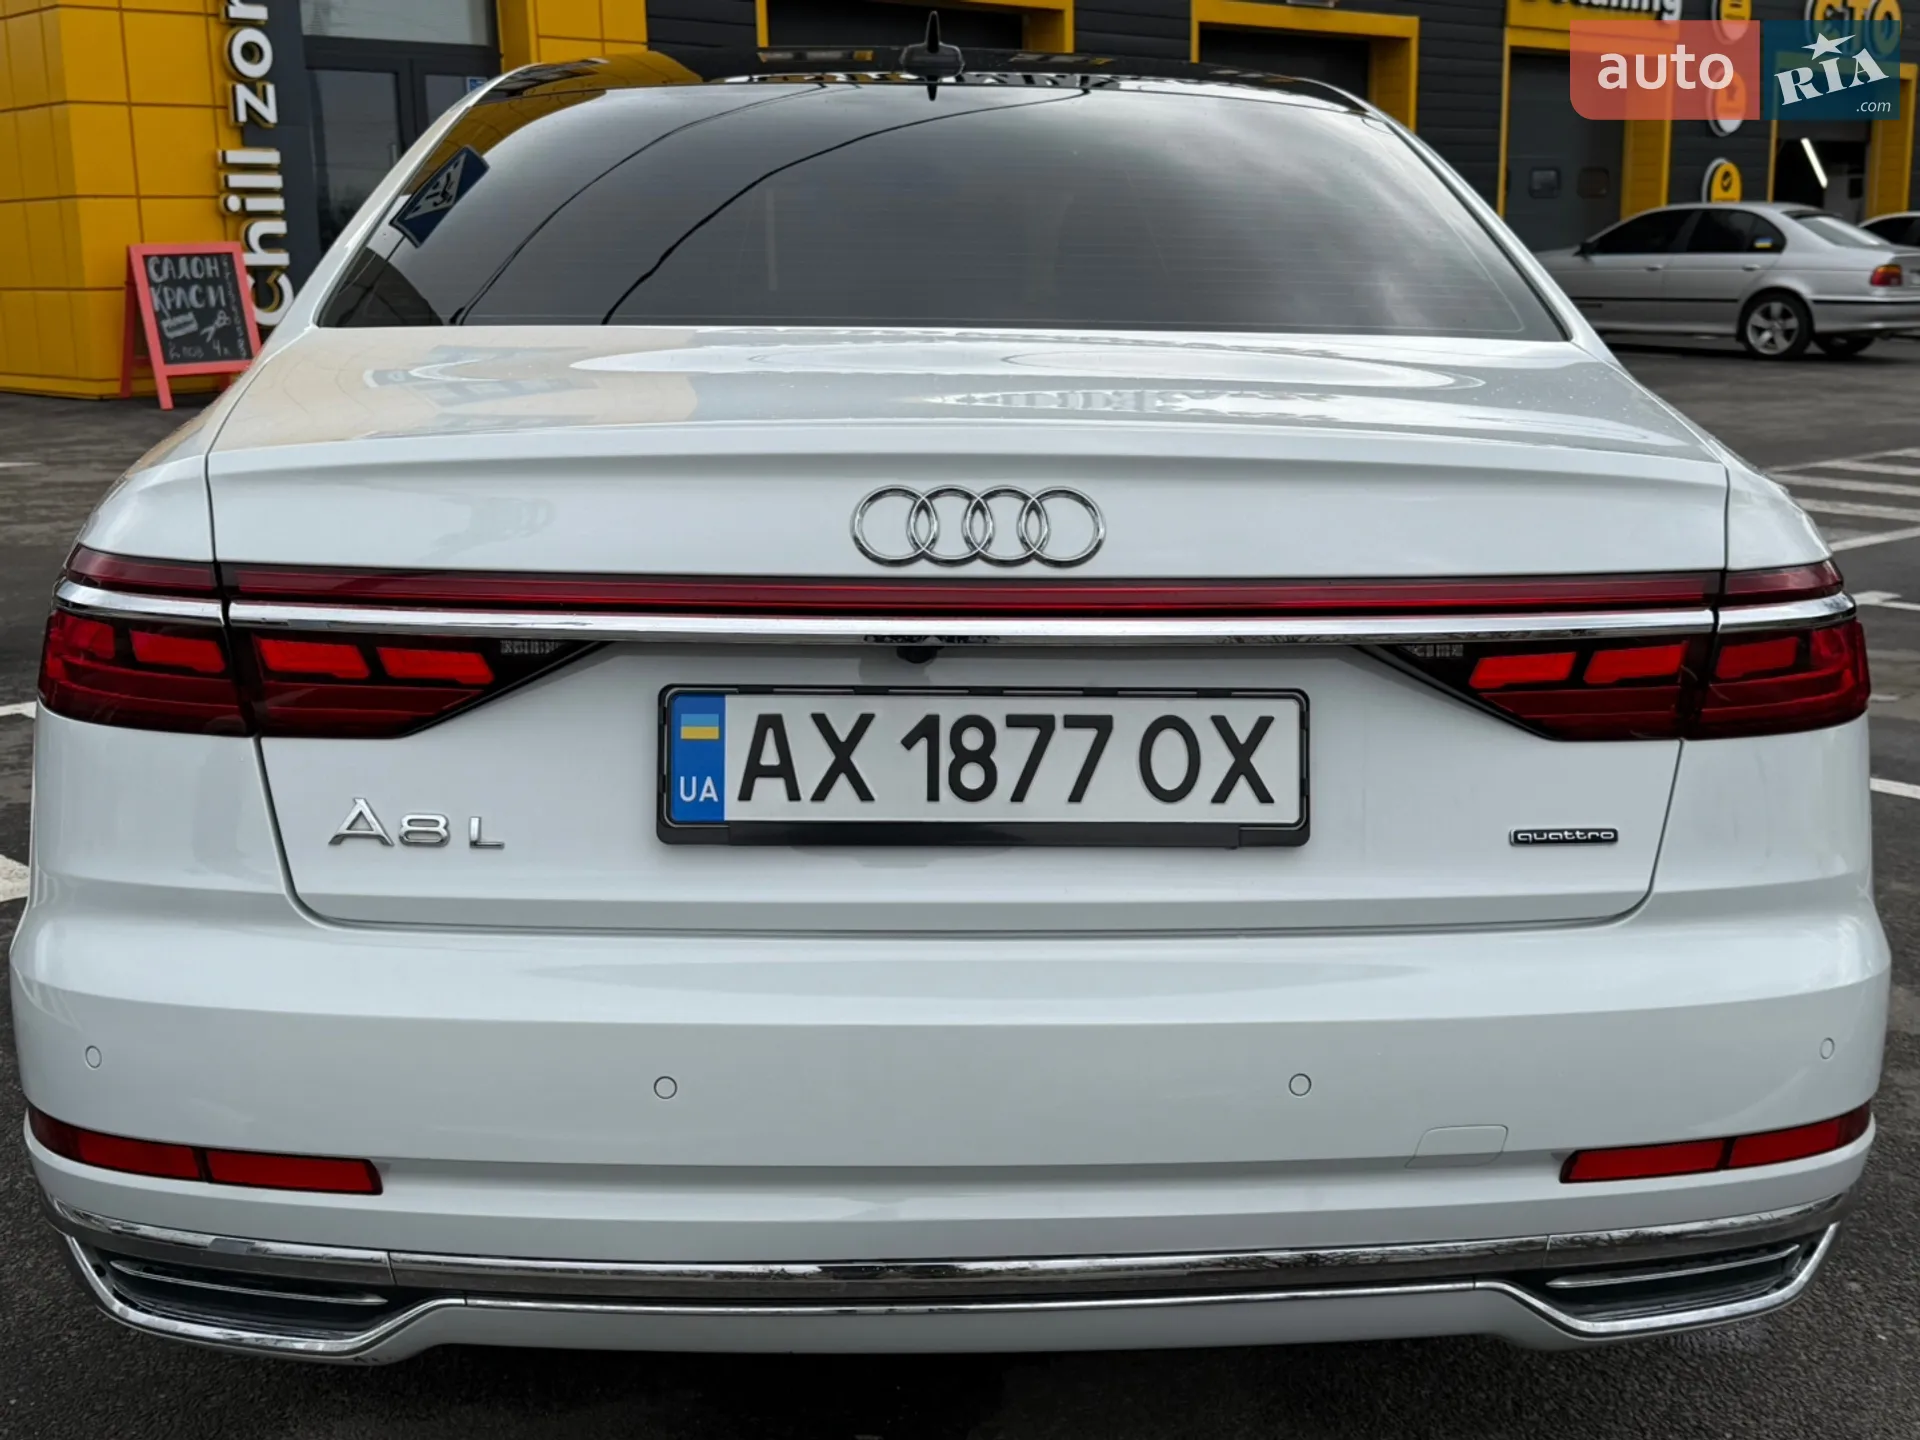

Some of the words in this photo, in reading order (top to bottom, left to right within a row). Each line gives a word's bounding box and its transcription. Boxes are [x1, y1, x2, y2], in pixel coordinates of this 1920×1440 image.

[224, 149, 295, 327] Chill
[148, 256, 220, 283] САЛОН
[150, 283, 227, 319] КРАСИ
[737, 713, 877, 803] AX
[900, 713, 1114, 803] 1877
[1138, 714, 1276, 804] OX
[679, 776, 720, 803] UA
[469, 815, 505, 850] L
[1516, 829, 1616, 845] quattro
